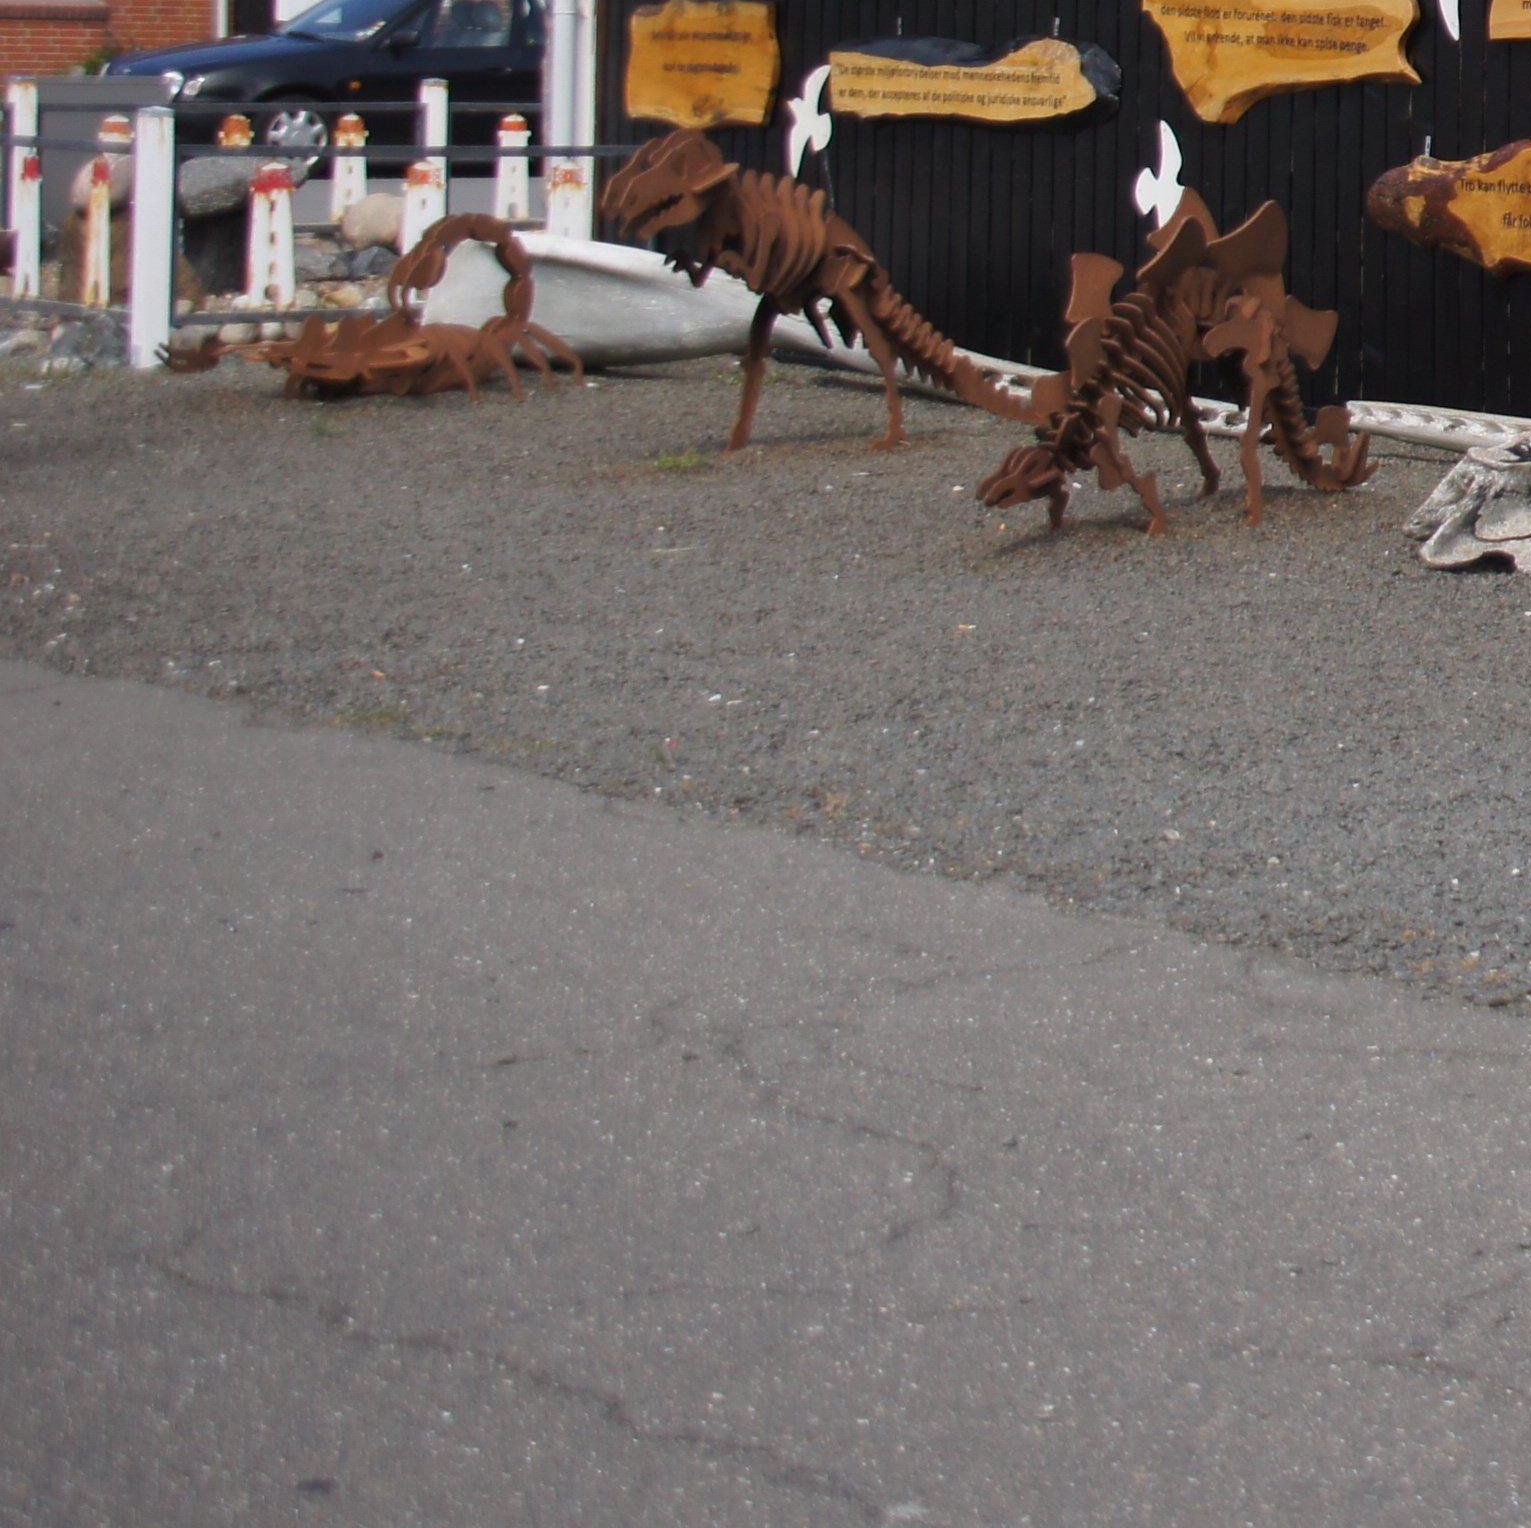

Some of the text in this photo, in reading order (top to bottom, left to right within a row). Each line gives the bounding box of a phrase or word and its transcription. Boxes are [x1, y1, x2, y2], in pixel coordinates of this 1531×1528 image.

[1460, 178, 1476, 192] Tro
[1478, 179, 1496, 192] kan
[1498, 179, 1526, 196] flytte
